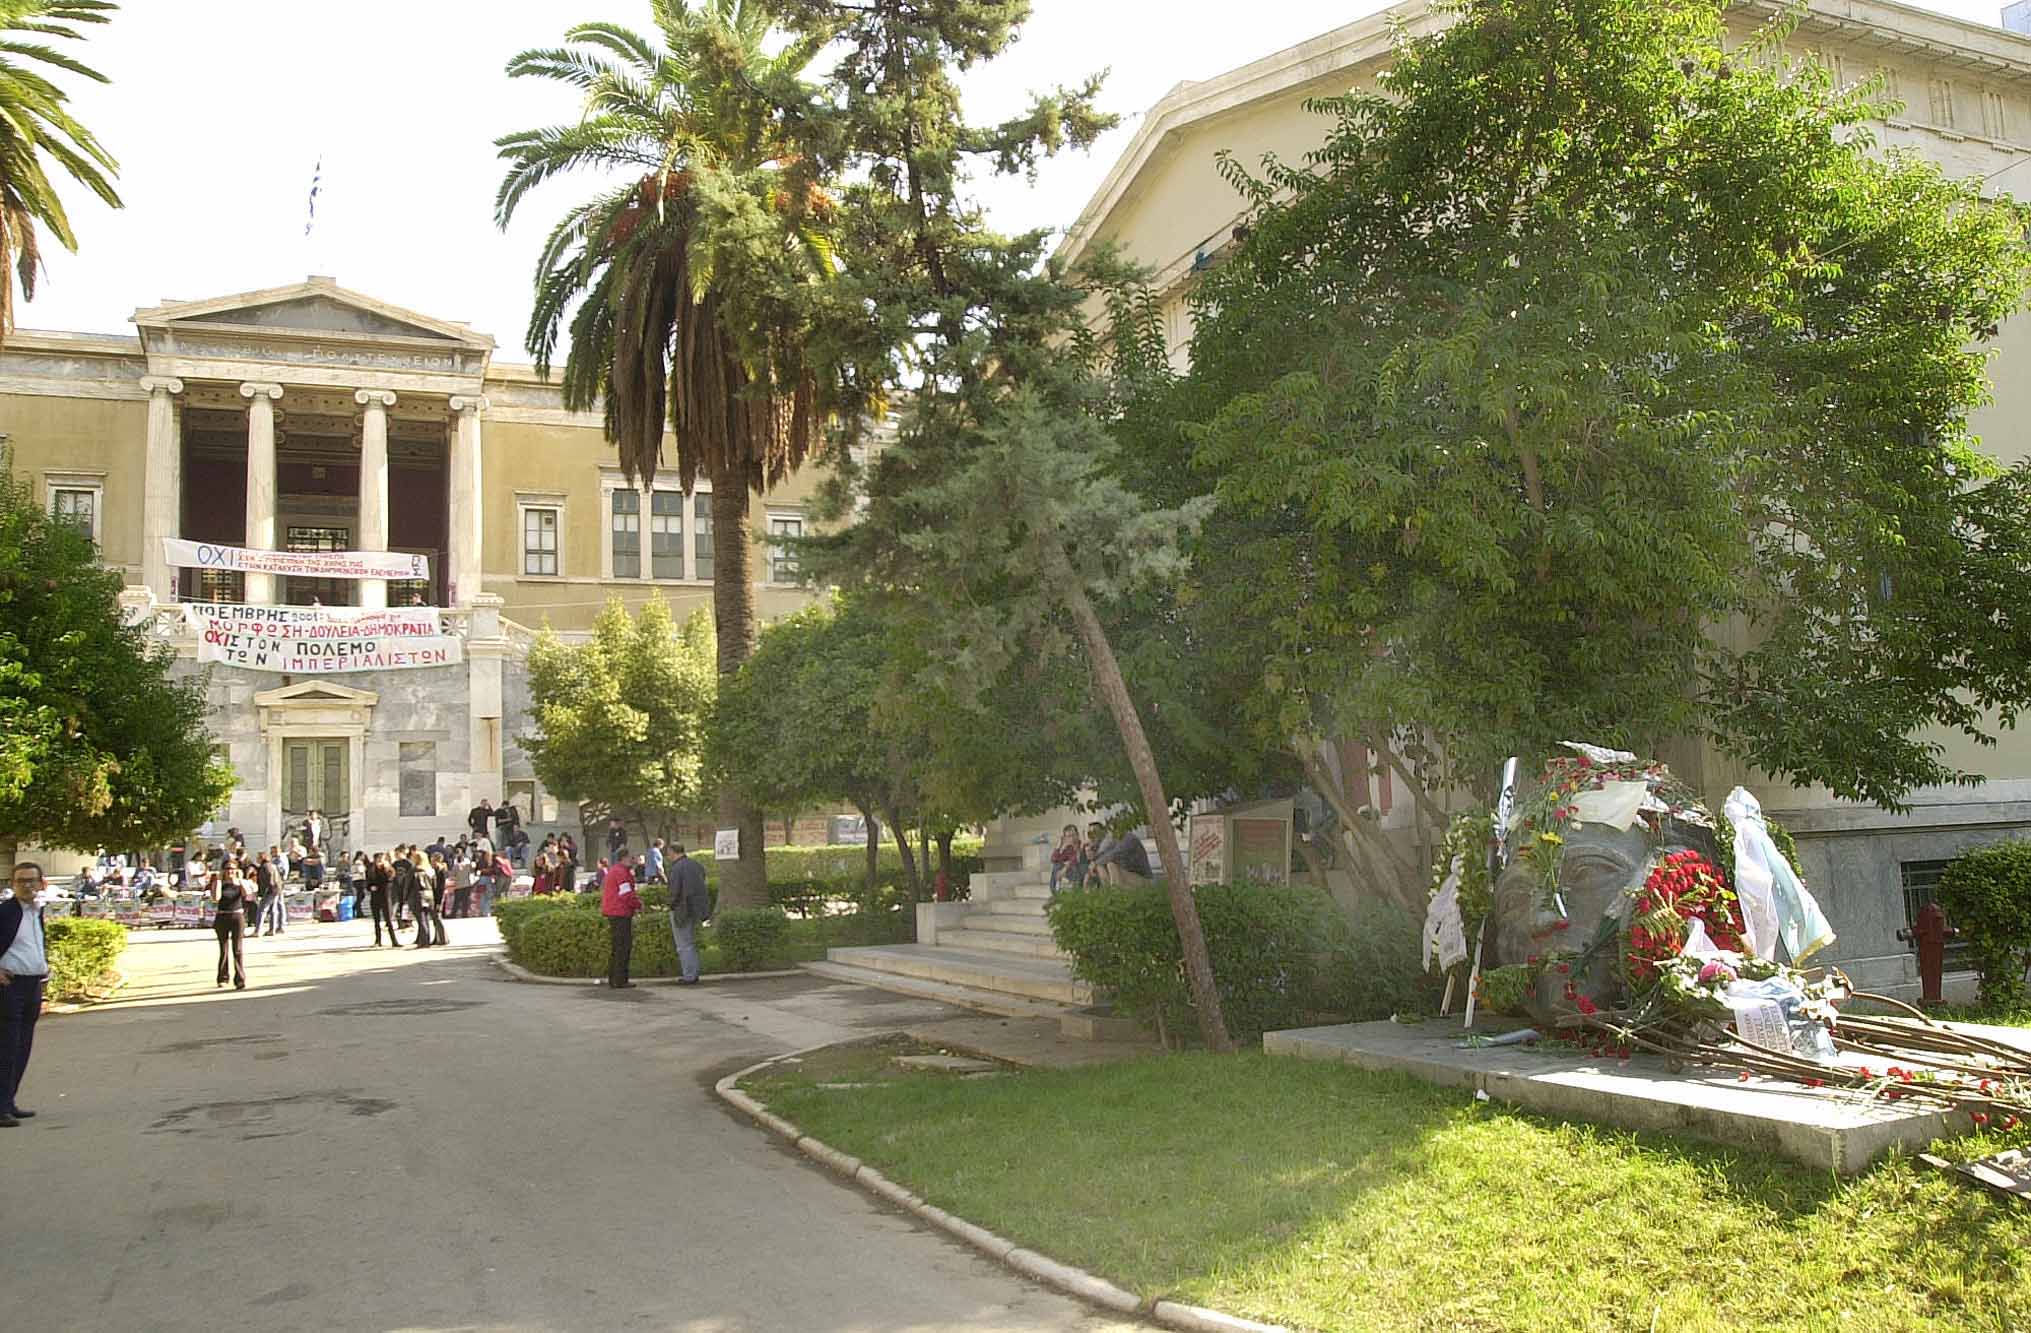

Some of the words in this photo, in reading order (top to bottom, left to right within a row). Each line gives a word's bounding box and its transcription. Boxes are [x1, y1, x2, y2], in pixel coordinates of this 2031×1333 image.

[197, 545, 234, 567] ΟΧΙ
[296, 641, 376, 656] ΠΟΛΕΜΟ
[226, 649, 268, 666] ΤΩΝ
[282, 649, 446, 671] ΙΜΠΕΡΙΑΛΙΣΤΩΝ
